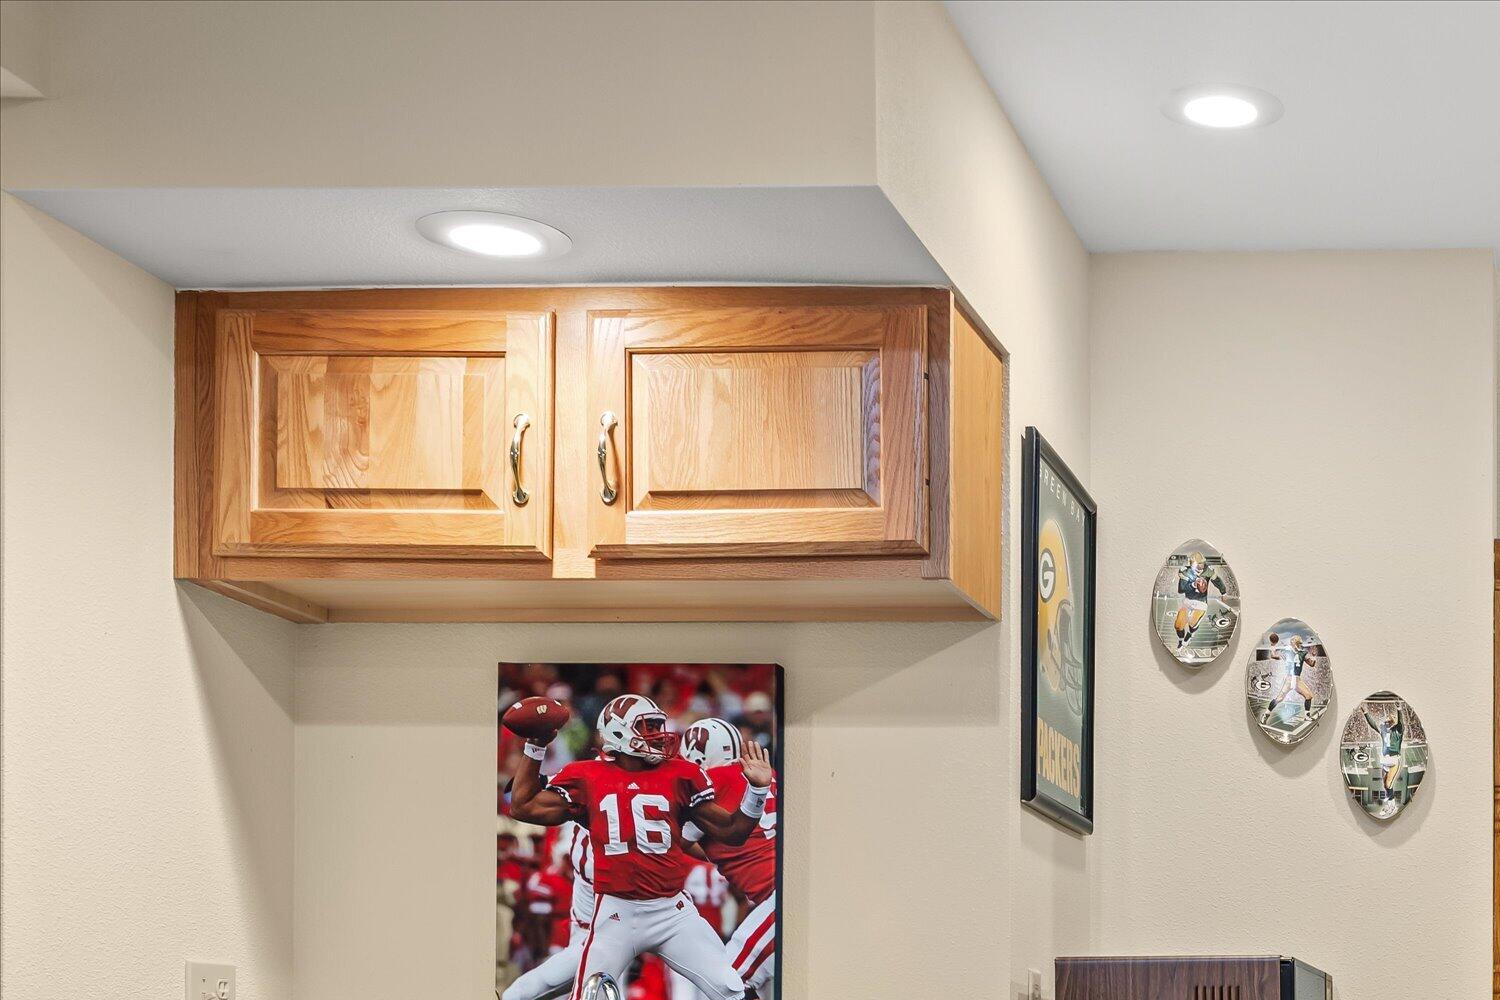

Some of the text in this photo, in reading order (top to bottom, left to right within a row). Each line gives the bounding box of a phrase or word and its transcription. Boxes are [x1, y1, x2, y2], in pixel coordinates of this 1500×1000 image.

[1040, 551, 1055, 599] G
[1036, 716, 1080, 799] PACKERS
[599, 793, 672, 856] 16
